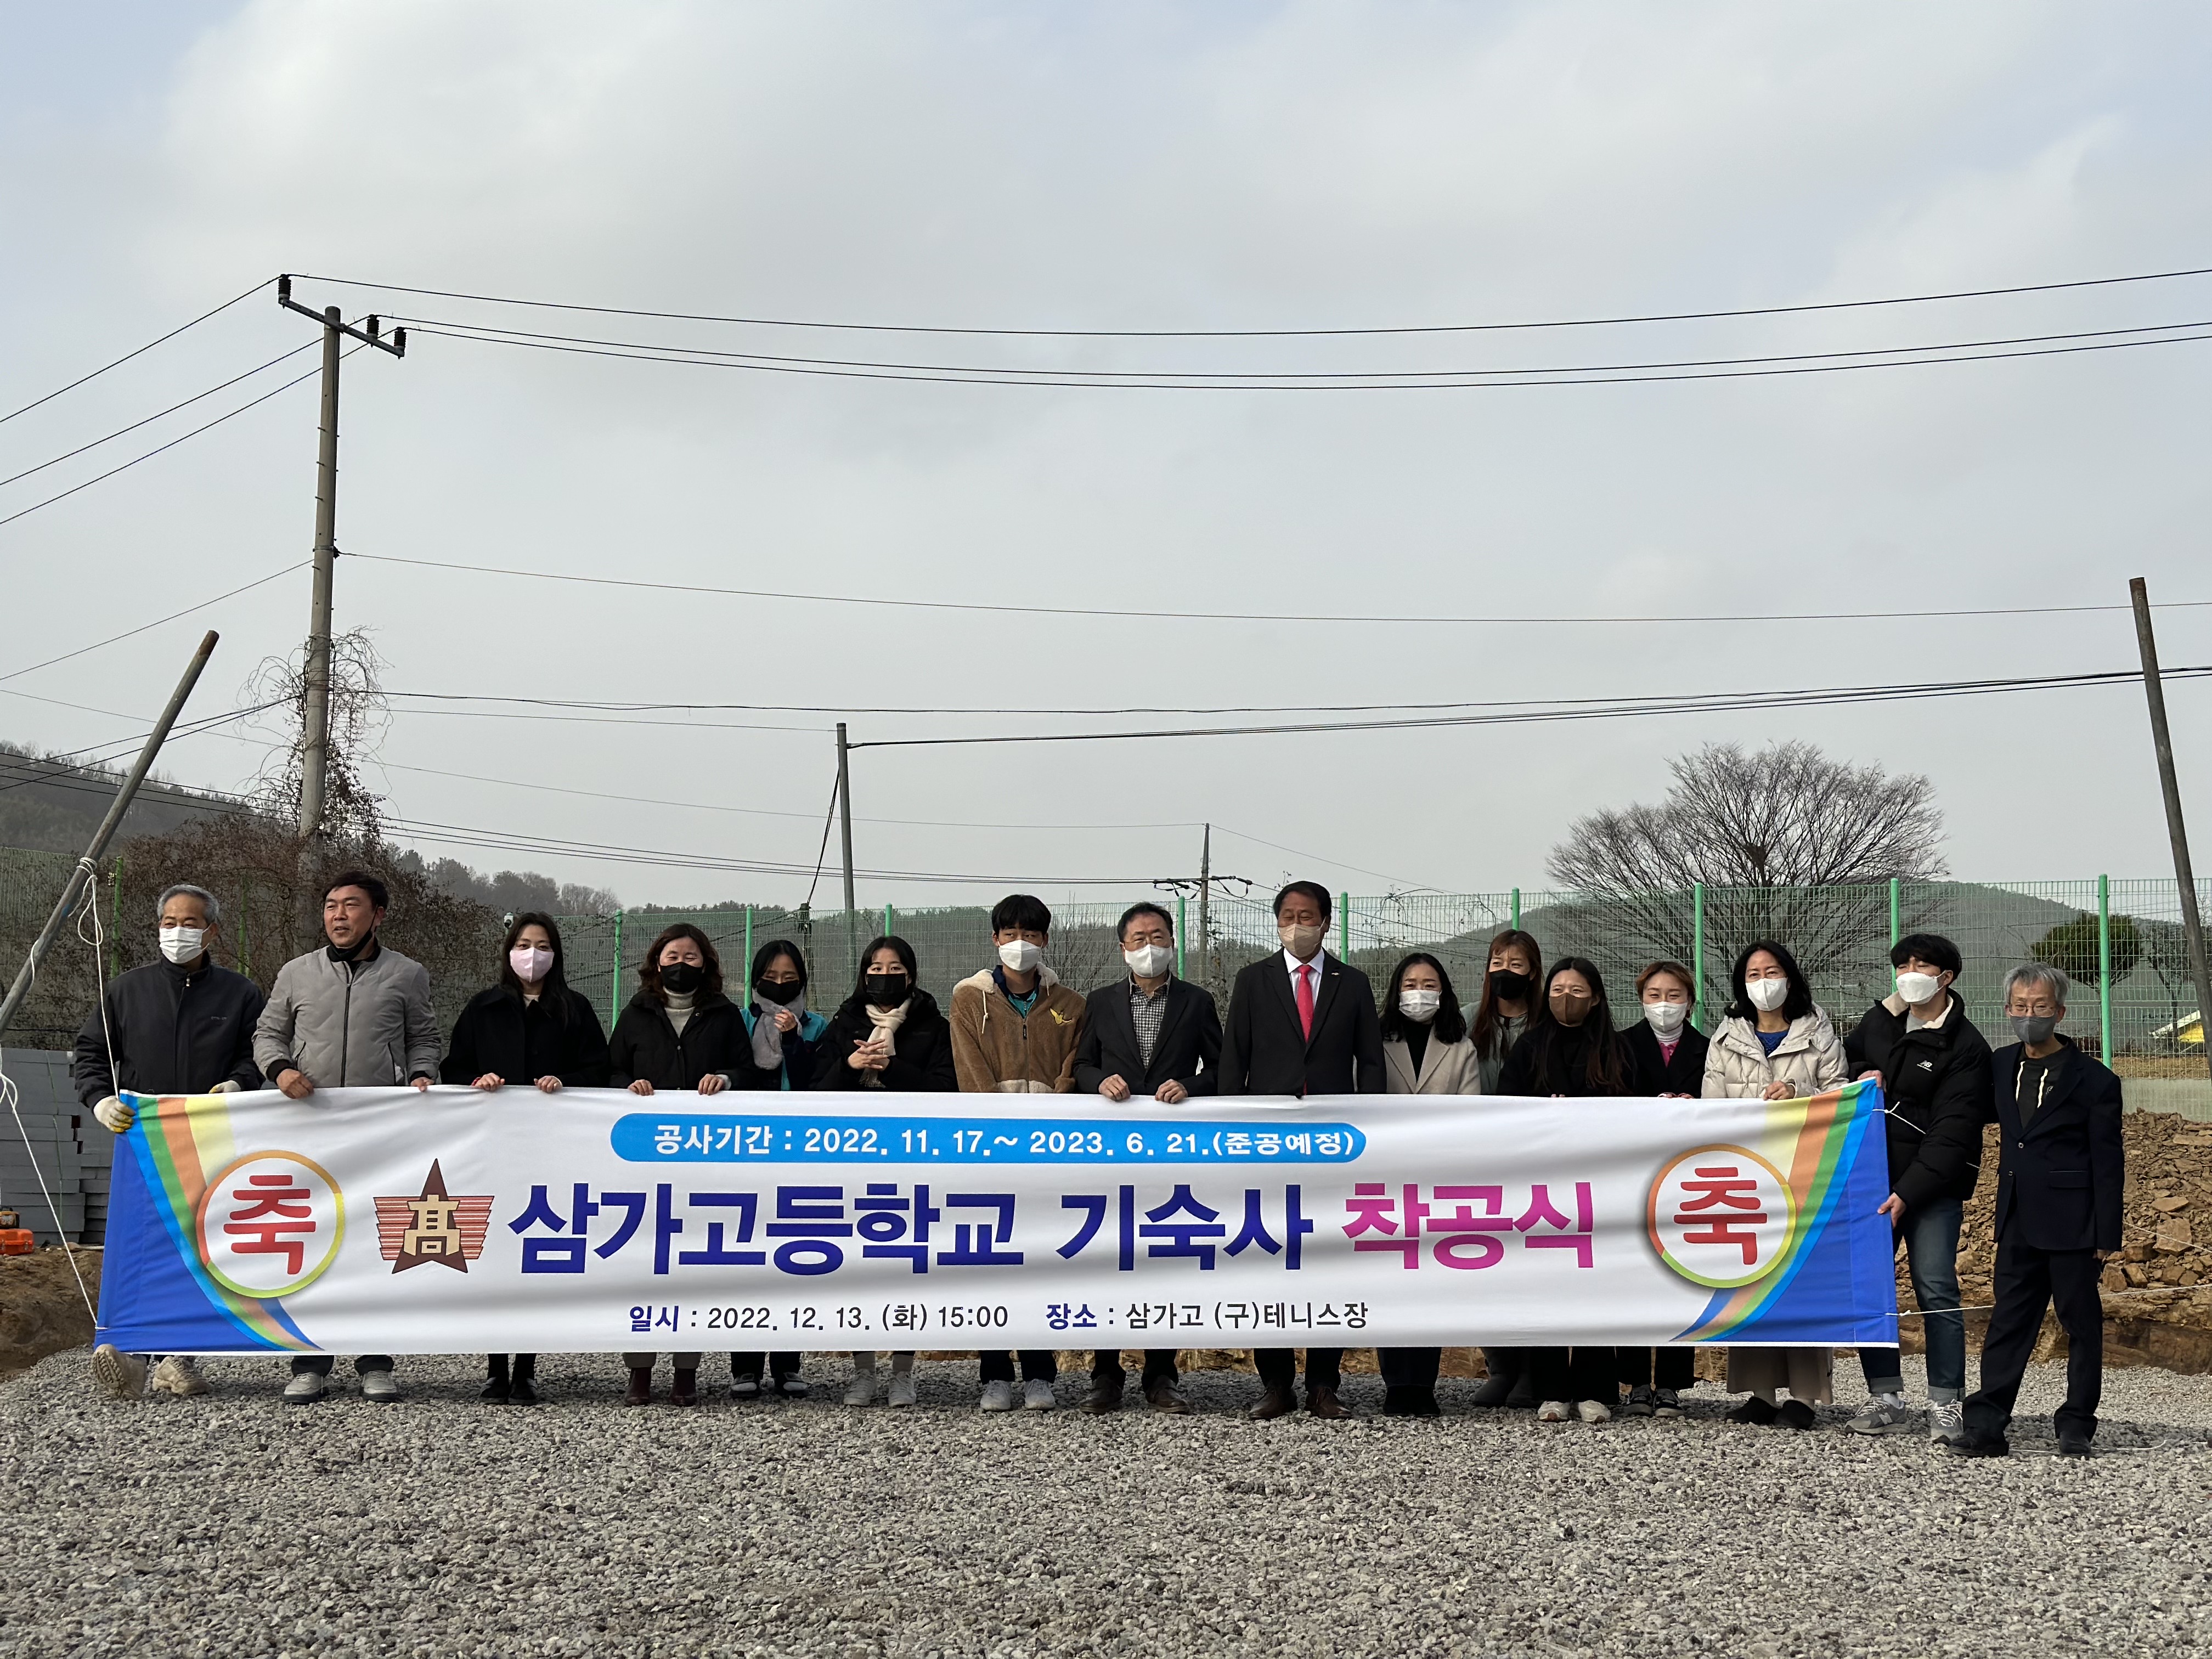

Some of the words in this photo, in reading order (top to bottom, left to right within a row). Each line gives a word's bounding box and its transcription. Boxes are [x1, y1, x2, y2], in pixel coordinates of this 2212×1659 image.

[654, 1125, 773, 1155] 공사기간
[804, 1128, 888, 1155] 2022.
[901, 1129, 939, 1155] 11.
[1030, 1131, 1113, 1156] 2023.
[1126, 1132, 1154, 1155] 6.
[224, 1175, 316, 1274] 축
[507, 1183, 1024, 1276] 삼가고등학교
[1056, 1184, 1314, 1271] 기숙사
[1342, 1182, 1593, 1270] 착공식
[1674, 1167, 1768, 1265] 축
[629, 1305, 679, 1332] 일시
[707, 1307, 777, 1331] 2022.
[790, 1307, 823, 1330] 12.
[836, 1307, 870, 1330] 13.
[882, 1304, 927, 1331] (화)
[938, 1306, 1008, 1328] 15:00
[1046, 1303, 1097, 1330] 장소
[1126, 1302, 1204, 1329] 삼가고
